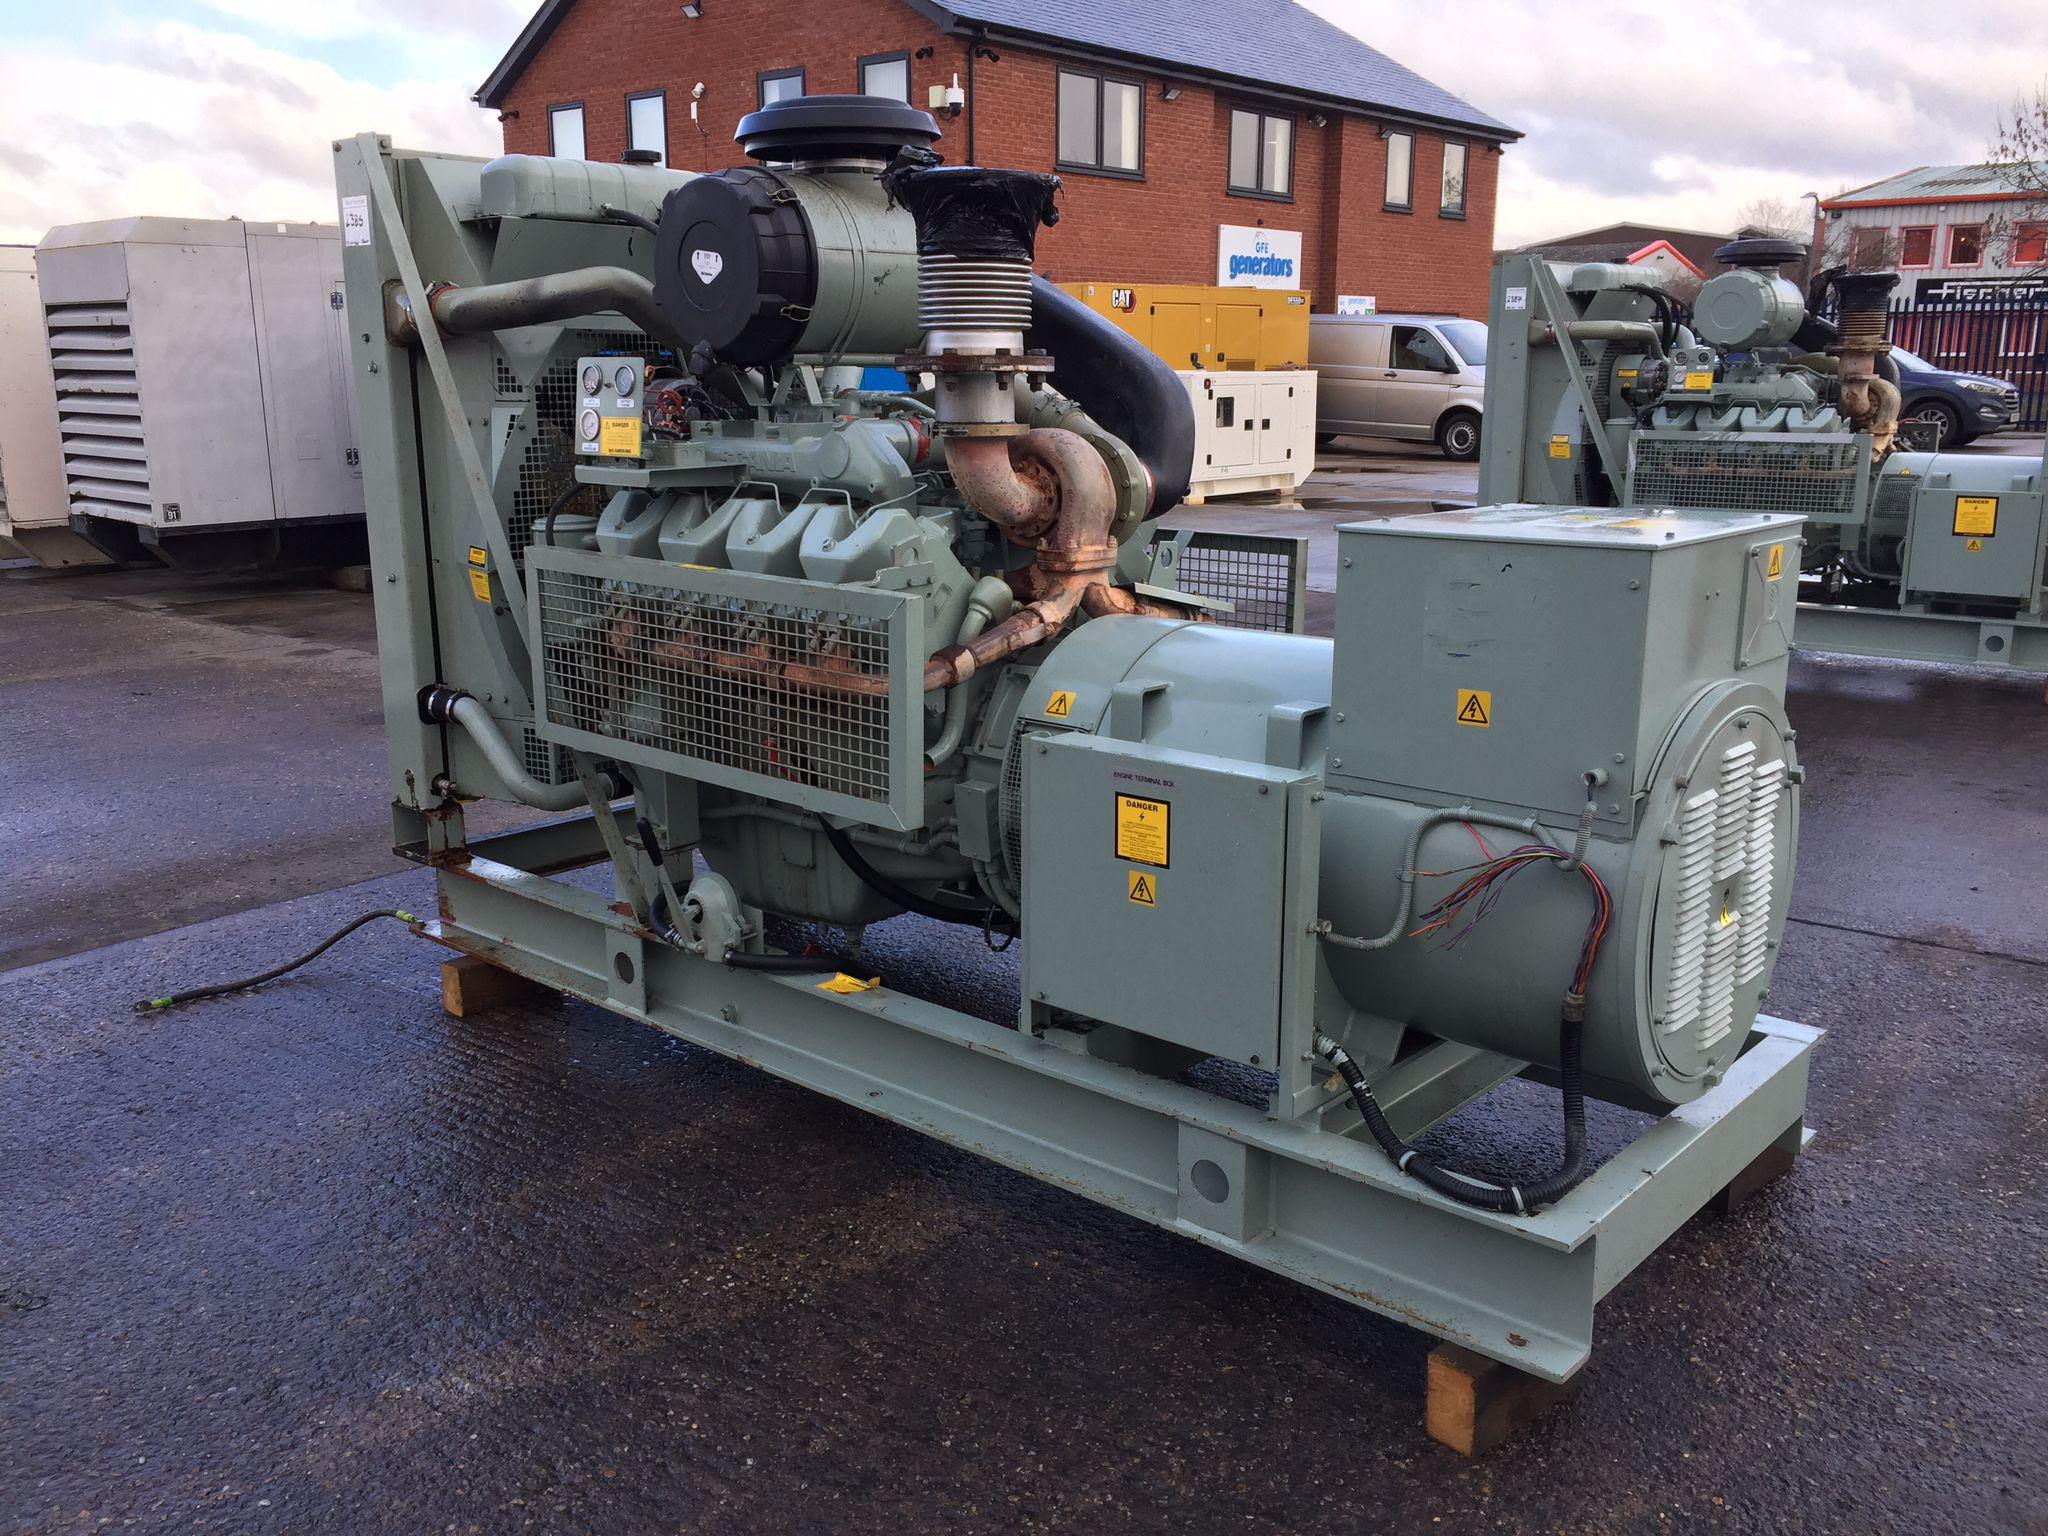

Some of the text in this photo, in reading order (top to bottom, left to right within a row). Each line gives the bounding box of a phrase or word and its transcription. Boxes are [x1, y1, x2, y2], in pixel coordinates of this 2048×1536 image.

[1255, 242, 1269, 253] GFE
[1229, 253, 1293, 279] generators
[1112, 289, 1131, 308] CAT
[167, 510, 177, 520] 91
[1113, 771, 1175, 788] ENGINE TERMINAL BOX
[1126, 800, 1159, 812] DANGER
